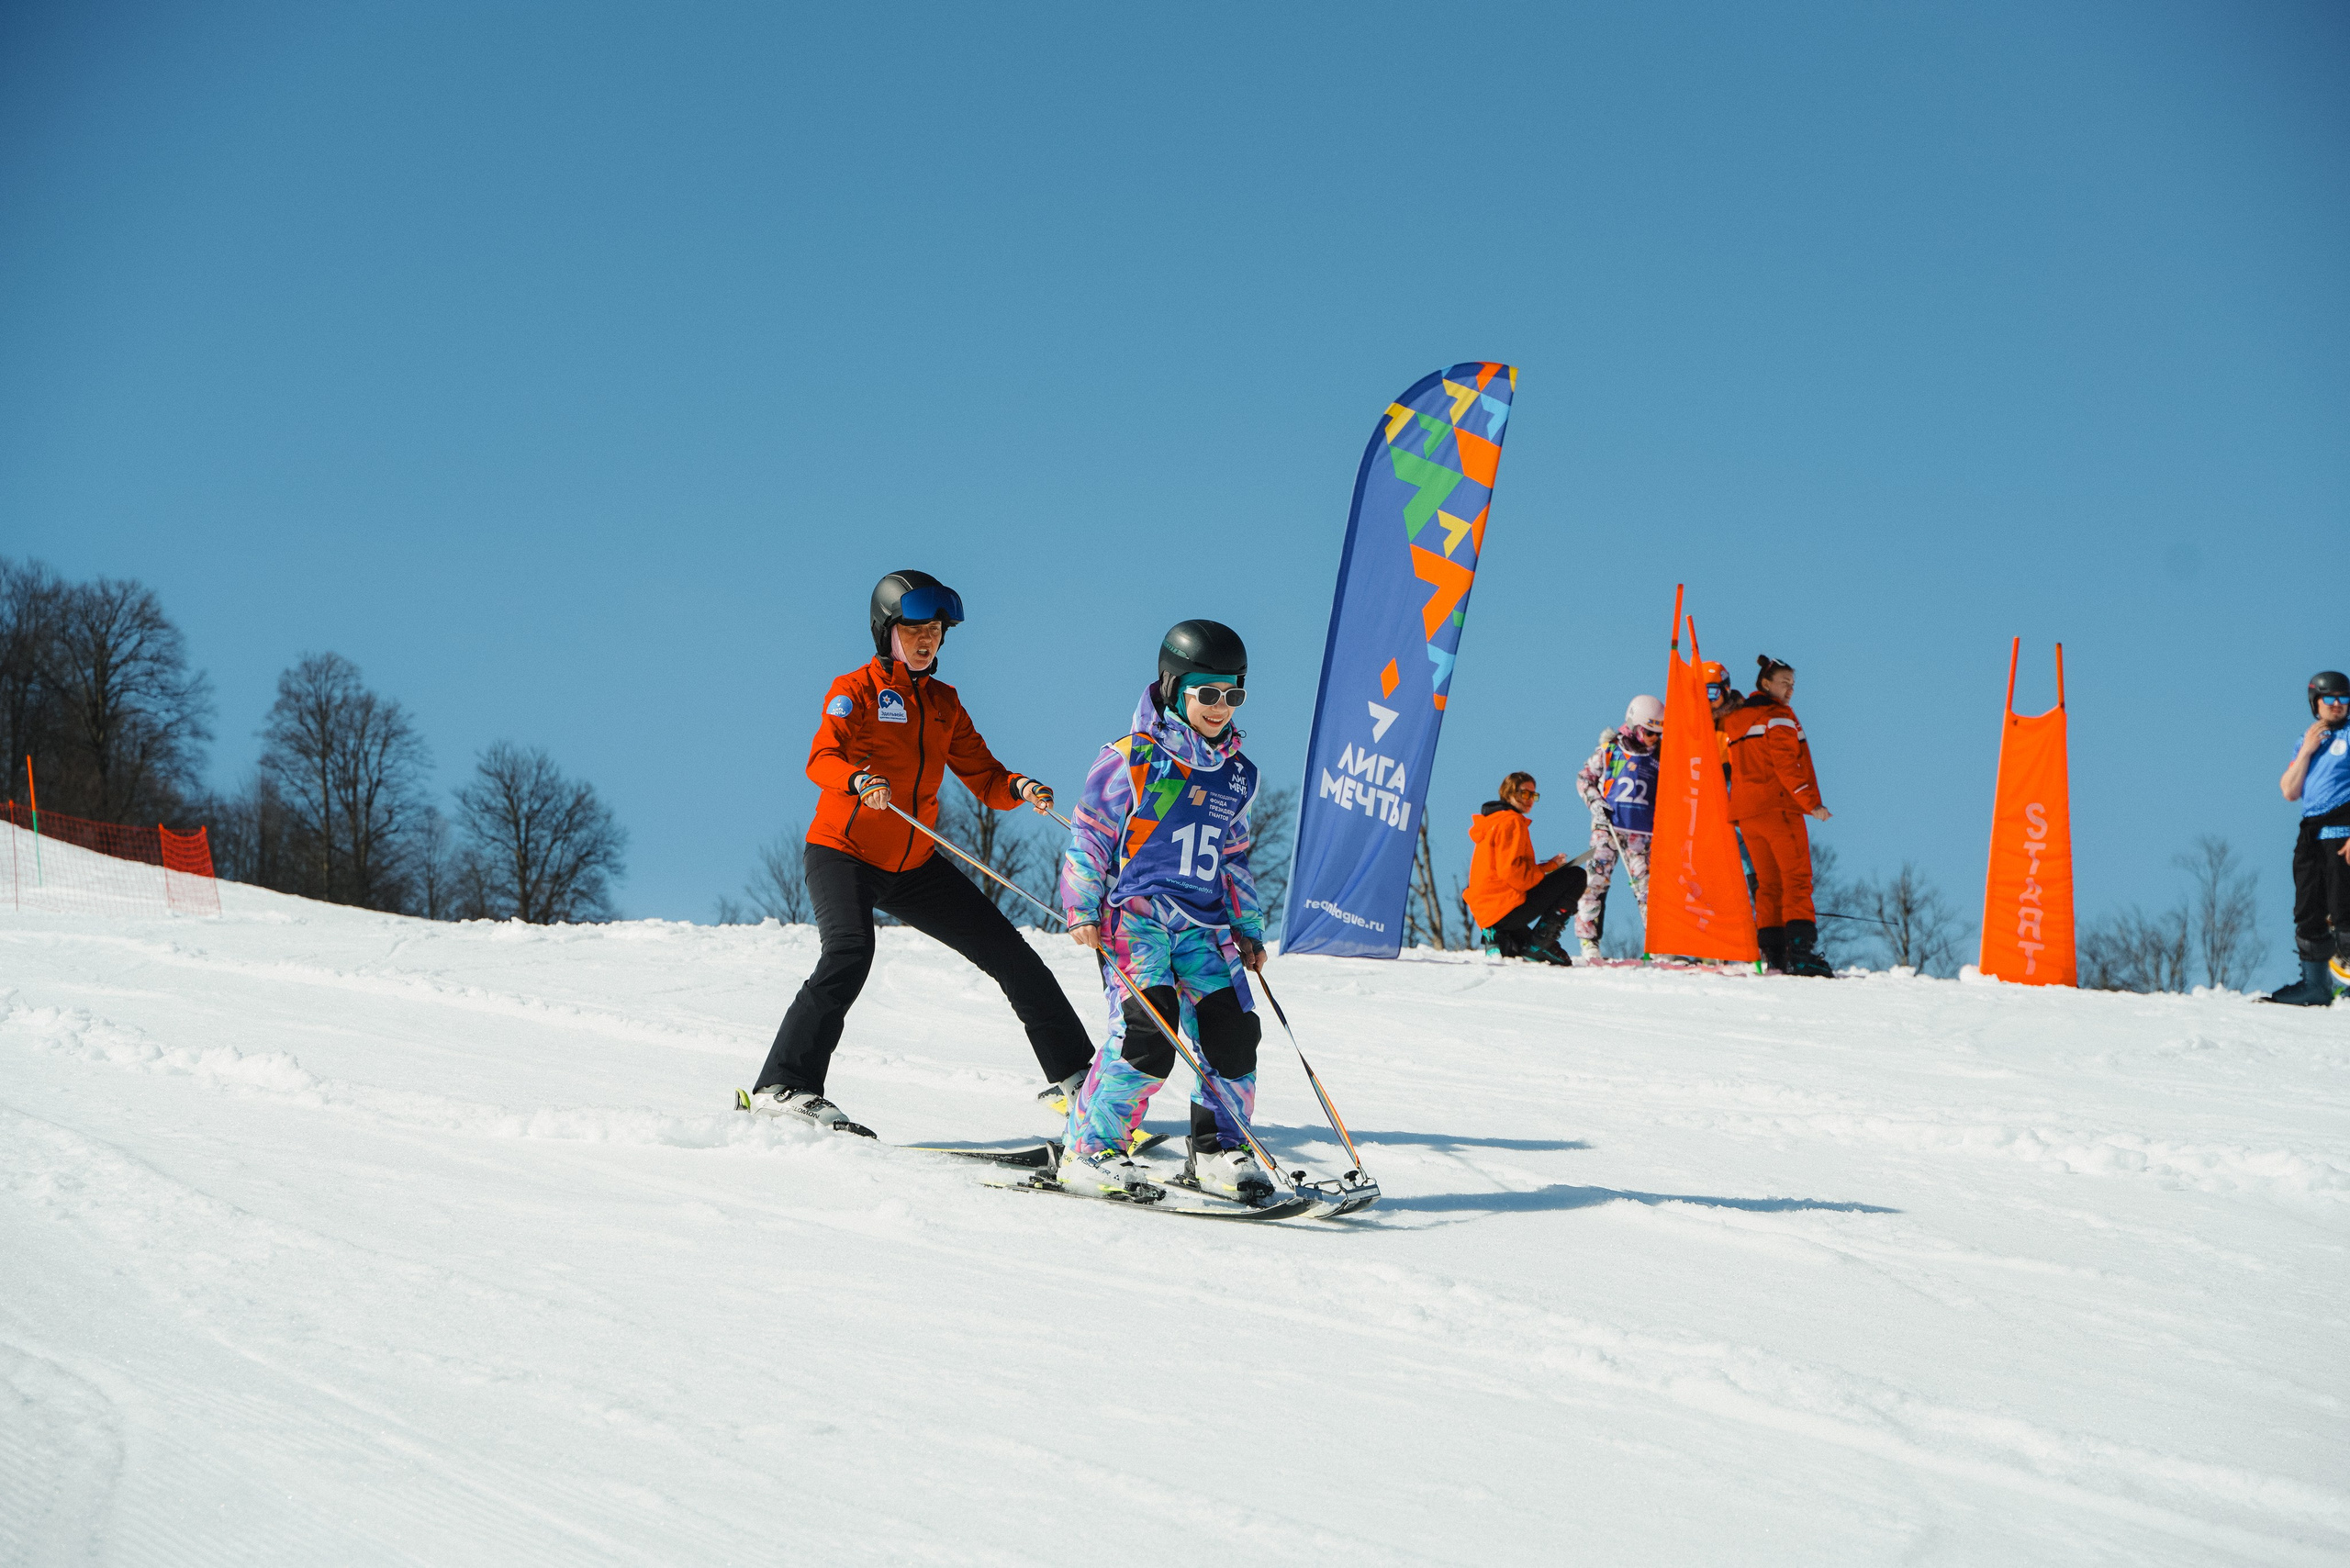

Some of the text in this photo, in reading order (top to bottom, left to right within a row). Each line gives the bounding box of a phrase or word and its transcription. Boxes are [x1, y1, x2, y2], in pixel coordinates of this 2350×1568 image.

[1337, 742, 1405, 795] ЛИГА
[1614, 777, 1650, 806] 22
[1209, 798, 1227, 807] ФОНДА
[1319, 767, 1412, 832] МЕЧТЫ
[1171, 822, 1222, 881] 15
[2016, 802, 2049, 976] START
